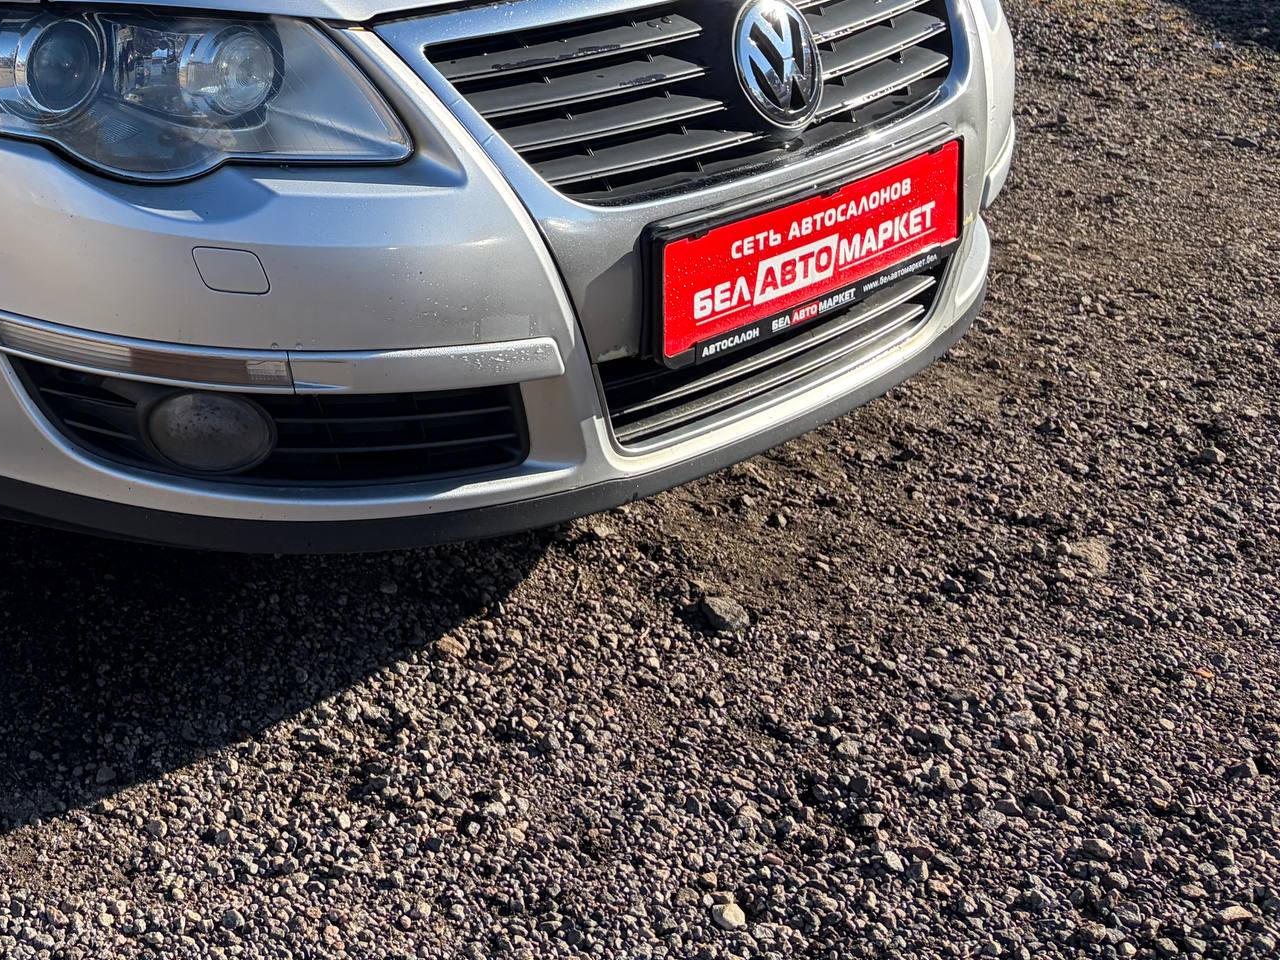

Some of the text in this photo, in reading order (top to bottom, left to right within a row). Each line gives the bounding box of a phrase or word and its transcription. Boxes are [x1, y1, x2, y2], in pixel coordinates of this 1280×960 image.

[731, 178, 911, 259] СЕТЬ АВТОСАЛОНОВ
[702, 327, 759, 357] АВТОСАЛОН
